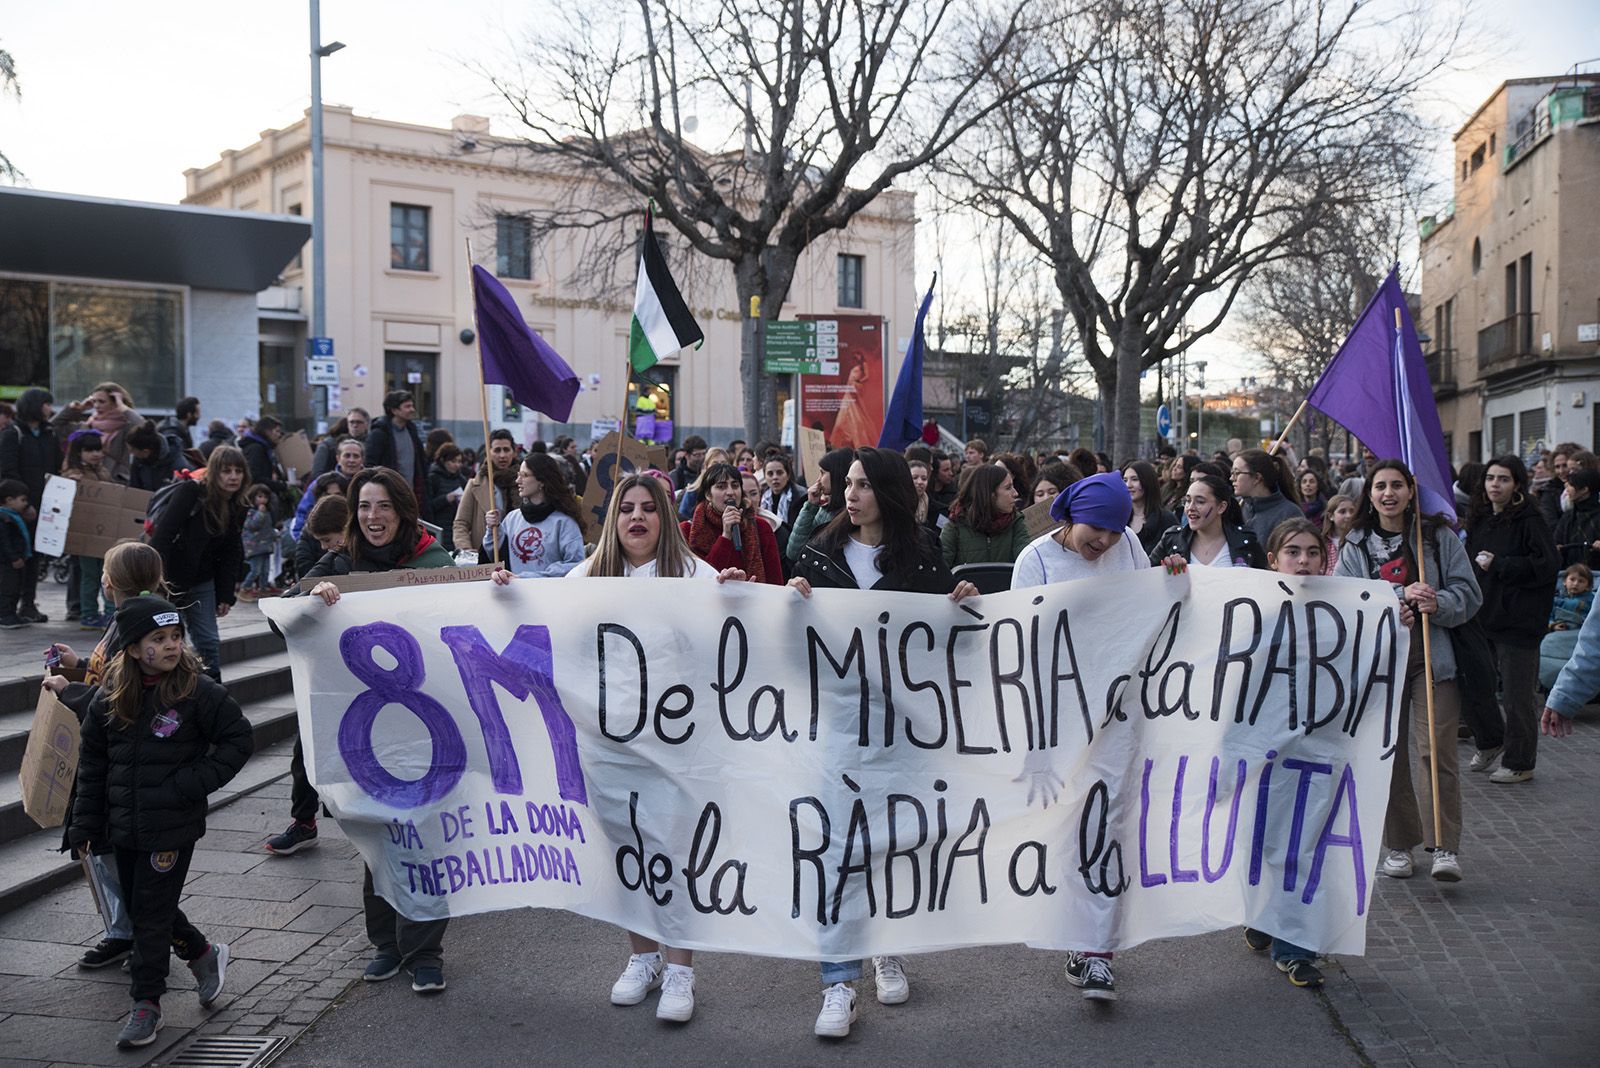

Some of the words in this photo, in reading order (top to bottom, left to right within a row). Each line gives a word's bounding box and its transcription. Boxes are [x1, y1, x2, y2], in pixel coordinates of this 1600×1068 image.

[338, 620, 588, 810] 8M
[597, 622, 696, 745] De
[710, 616, 799, 743] la
[1138, 600, 1200, 721] la
[401, 843, 582, 896] TREBALLADORA
[440, 805, 475, 843] DE
[485, 801, 519, 835] LA
[526, 800, 586, 844] DONA
[616, 791, 673, 906] de
[682, 801, 757, 915] la
[1008, 840, 1058, 897] a
[1078, 779, 1131, 898] la
